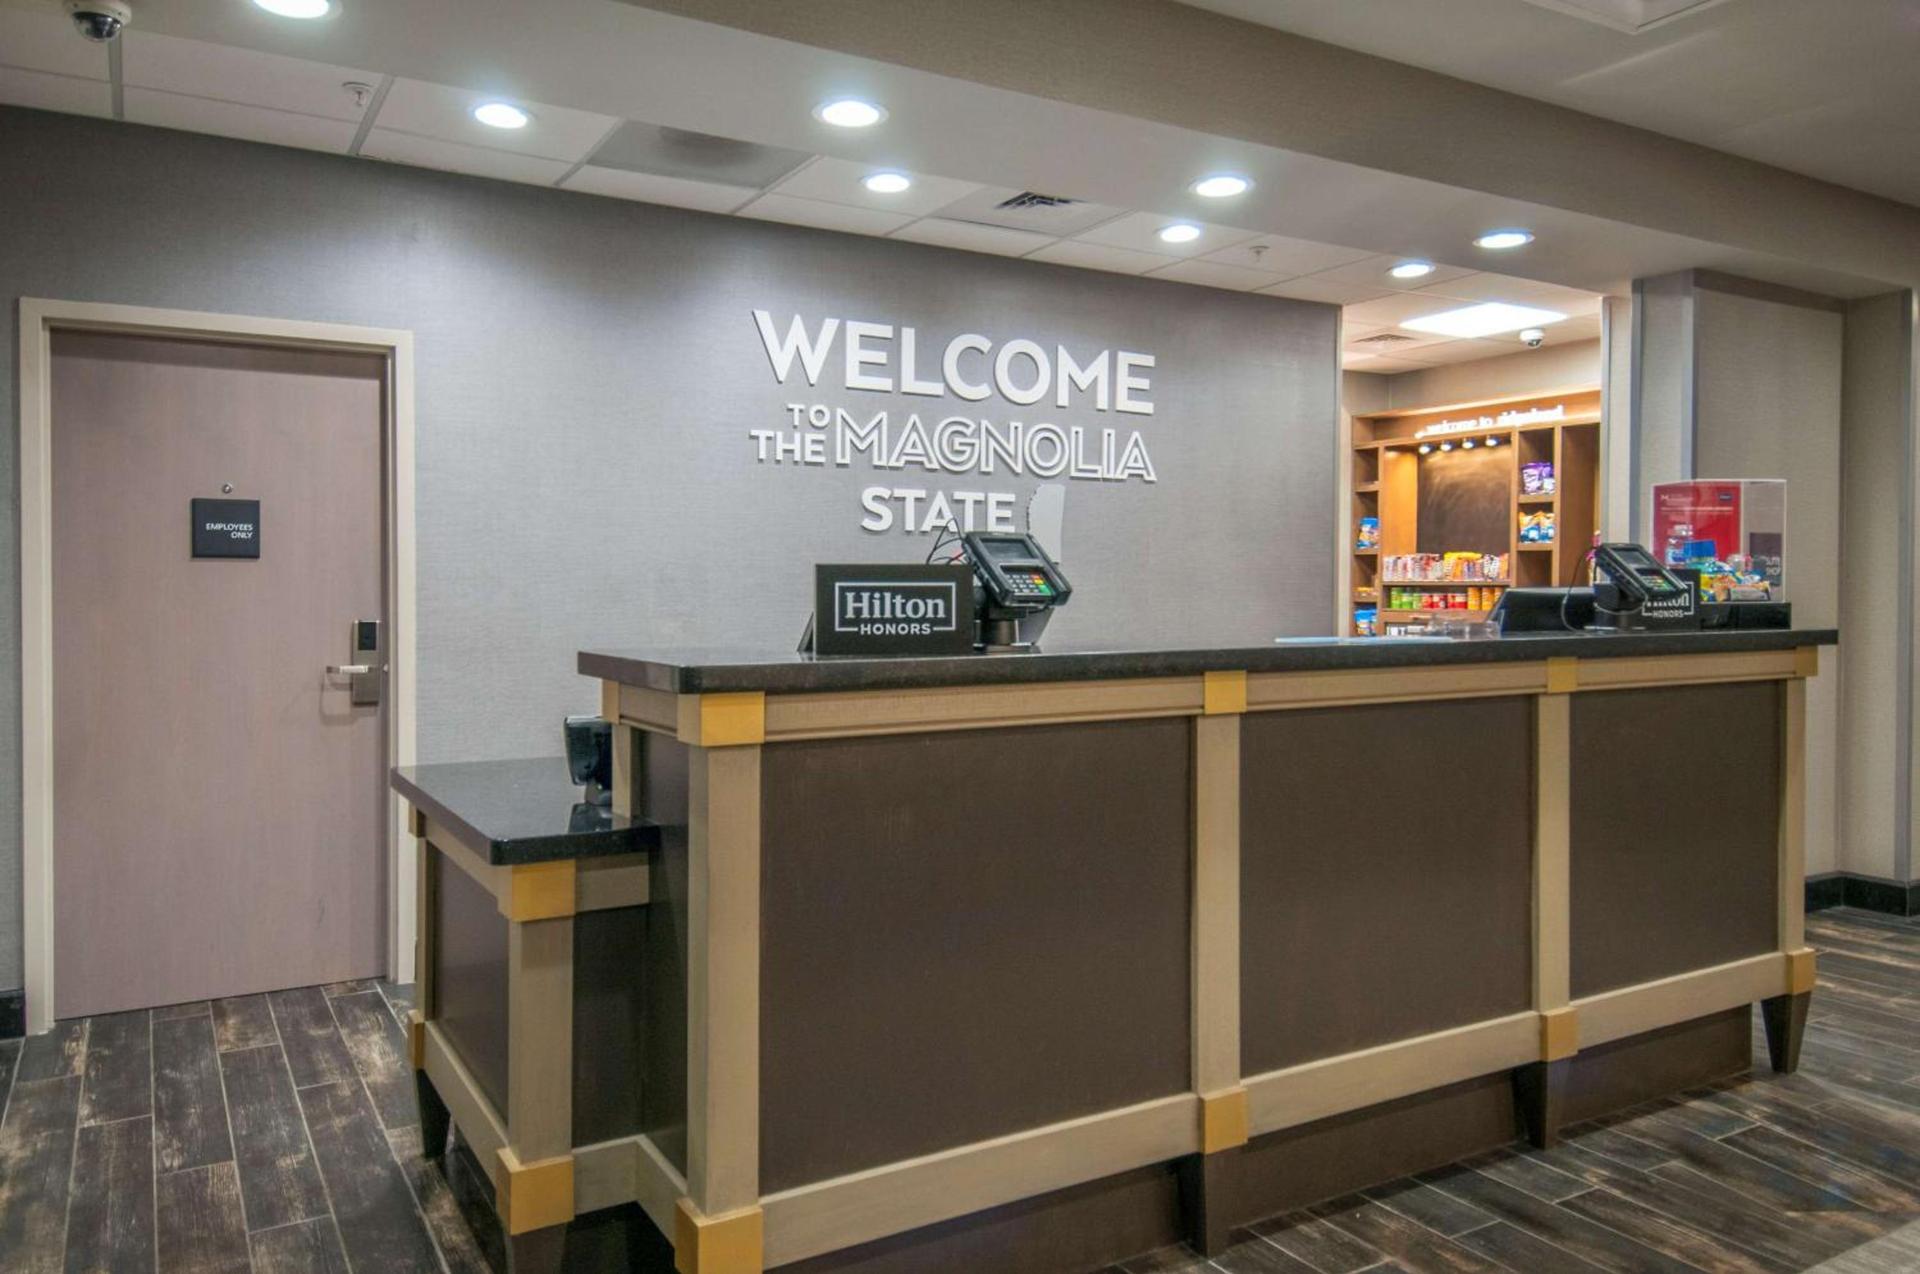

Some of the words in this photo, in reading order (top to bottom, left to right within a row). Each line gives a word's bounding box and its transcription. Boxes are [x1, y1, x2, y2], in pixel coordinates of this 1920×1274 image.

[753, 309, 1156, 414] WELCOME
[787, 403, 830, 428] TO
[750, 429, 826, 463] THE
[836, 407, 1158, 482] MAGNOLIA
[860, 487, 1016, 533] STATE
[205, 522, 253, 531] EMPLOYEES
[230, 531, 253, 539] ONLY
[844, 591, 947, 619] Hilton
[1652, 610, 1684, 618] HONORS
[860, 623, 931, 636] HONORS
